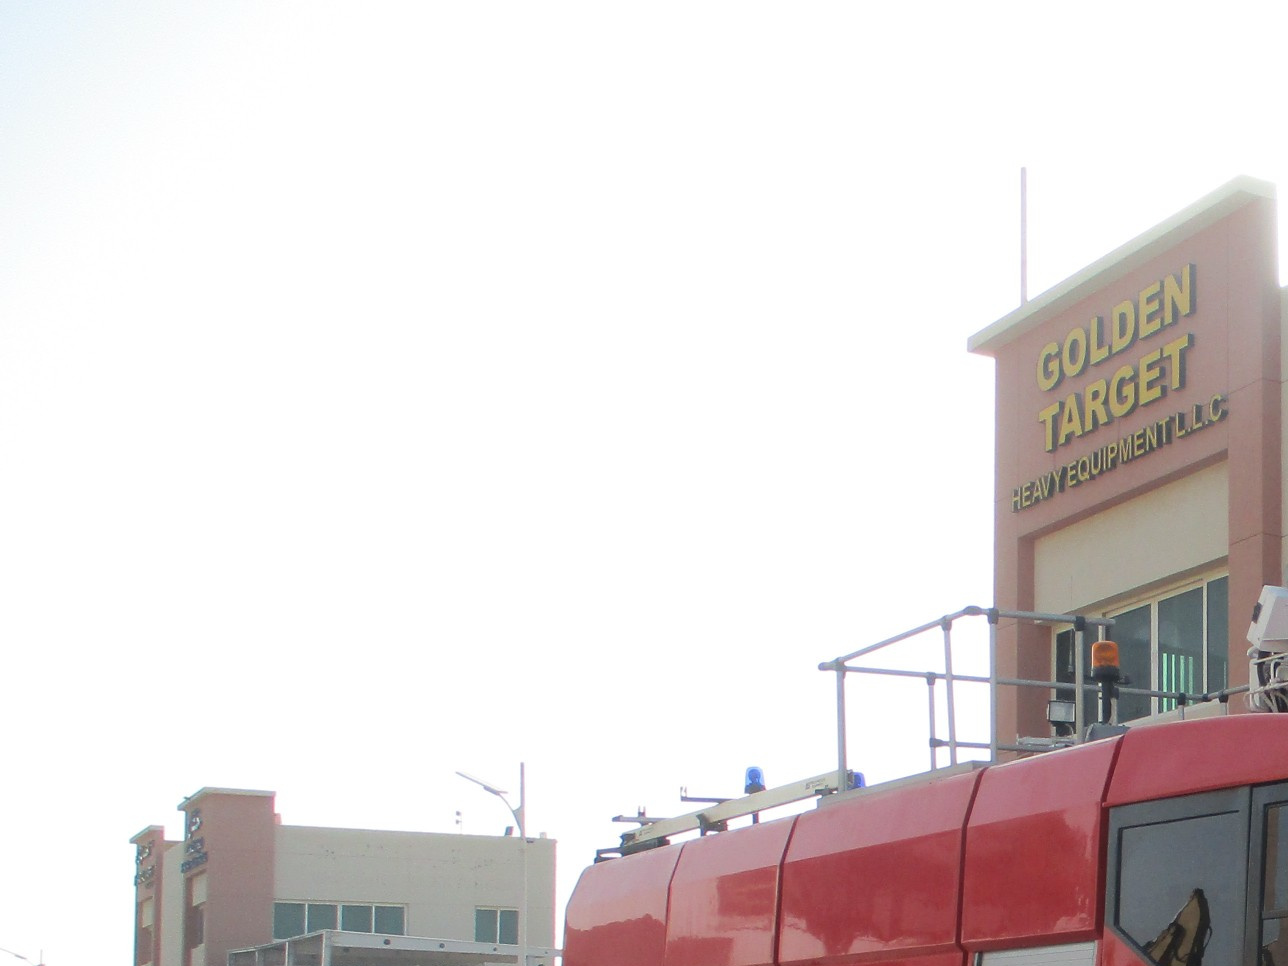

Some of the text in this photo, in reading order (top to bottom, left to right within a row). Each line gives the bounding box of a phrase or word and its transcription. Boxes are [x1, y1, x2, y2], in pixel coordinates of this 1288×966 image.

[1036, 263, 1197, 392] GOLDEN
[1011, 393, 1228, 513] HEAVY EQUIPMENT L.L.C
[1038, 333, 1194, 454] TARGET
